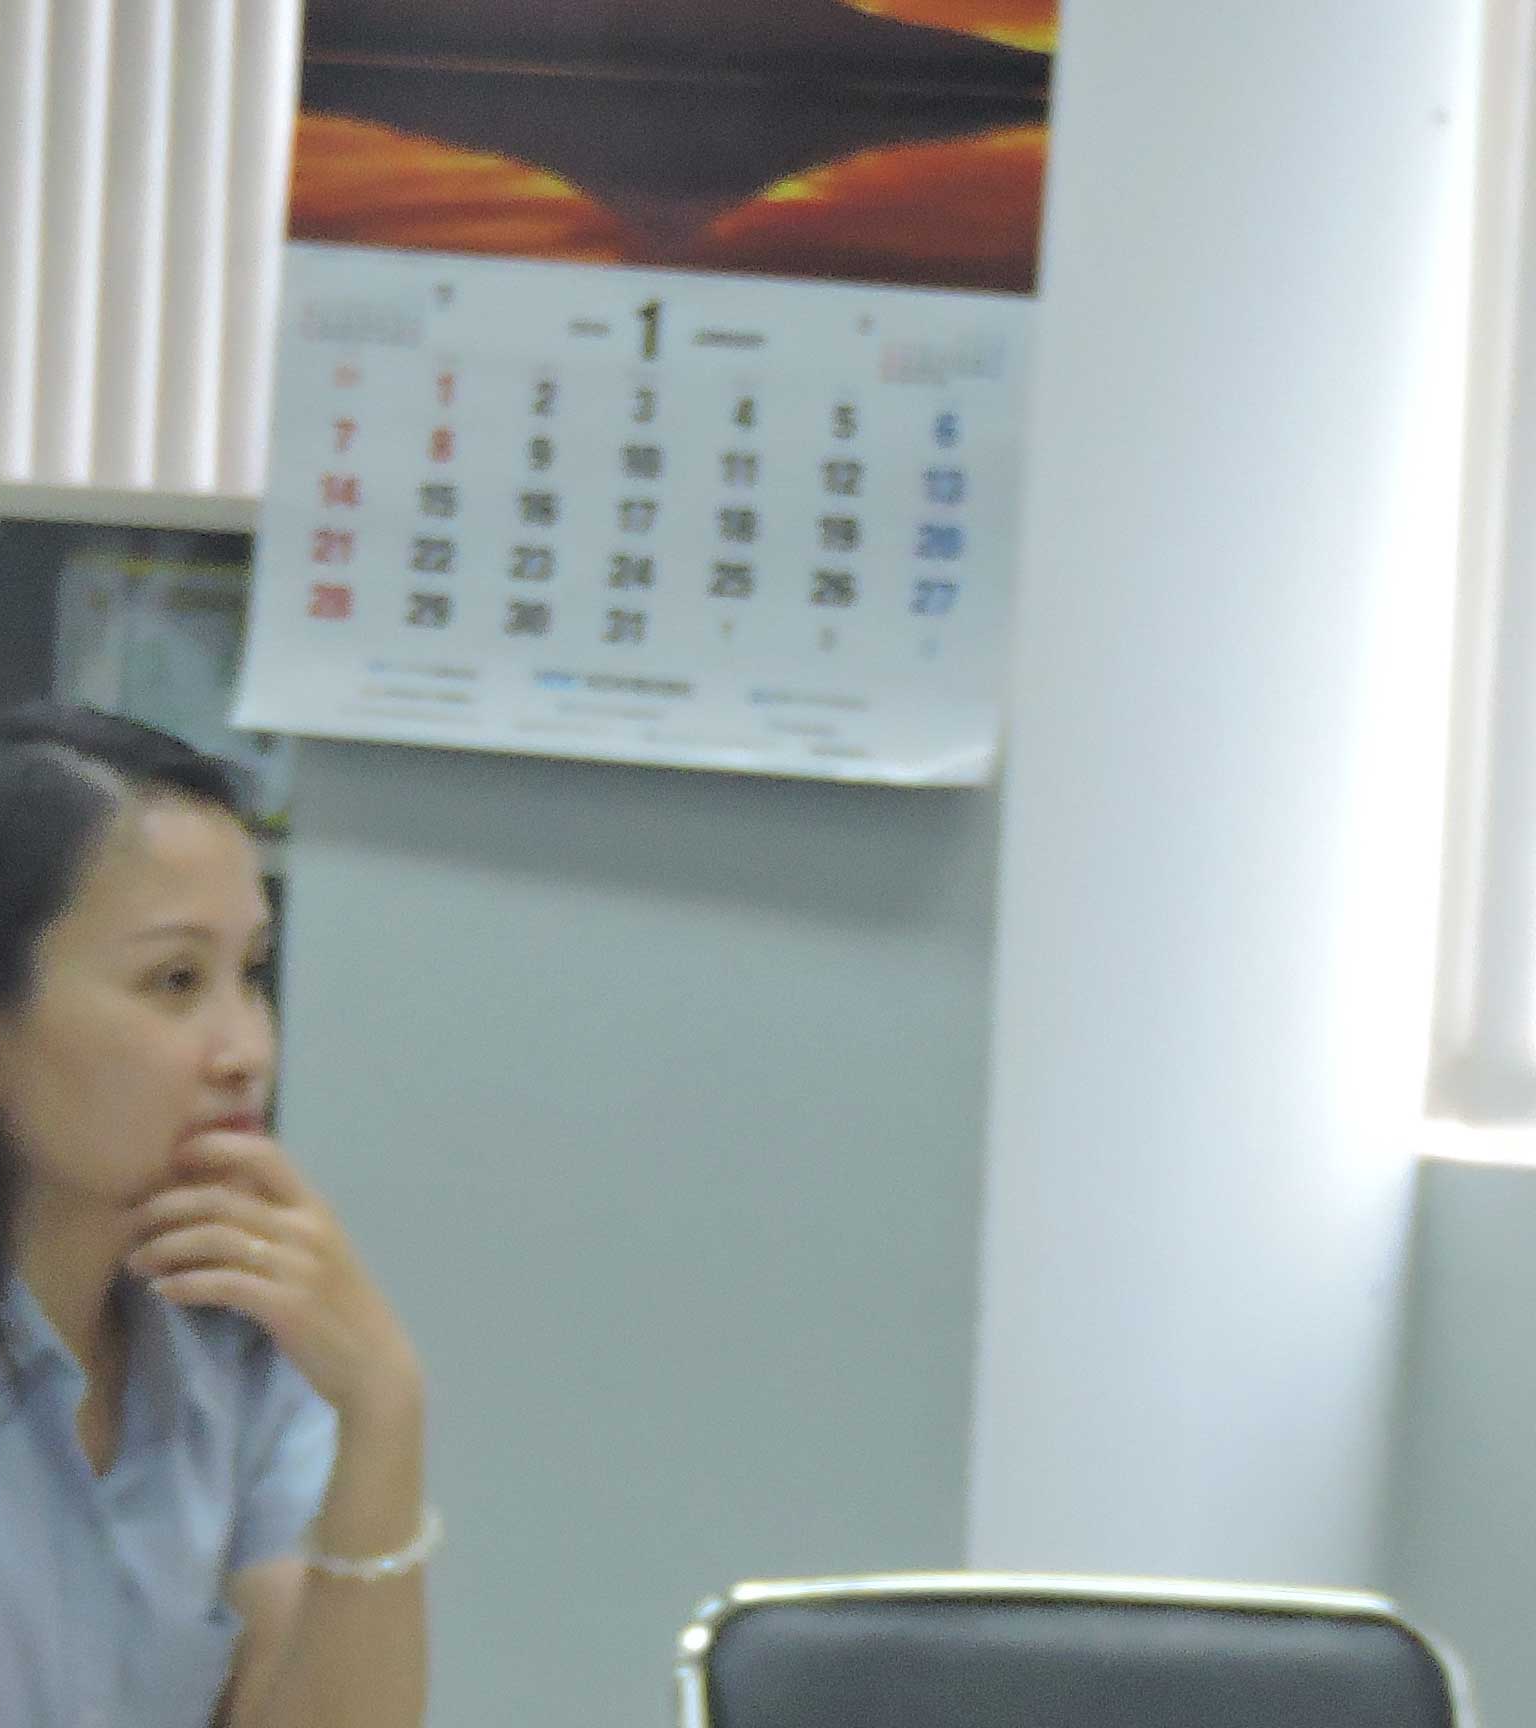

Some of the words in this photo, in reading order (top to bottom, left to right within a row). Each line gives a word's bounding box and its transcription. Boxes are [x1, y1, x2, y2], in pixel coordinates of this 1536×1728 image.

[638, 298, 662, 362] 1
[436, 372, 454, 404] 1
[534, 379, 556, 416] 2
[634, 388, 654, 423] 3
[733, 397, 757, 430] 4
[835, 404, 857, 440] 5
[935, 412, 960, 449] 6
[334, 418, 357, 450] 7
[430, 427, 452, 461] 8
[529, 437, 553, 472] 9
[623, 443, 662, 479] 10
[723, 451, 759, 484] 11
[824, 459, 863, 496] 12
[925, 468, 965, 505] 13
[323, 474, 359, 506] 14
[419, 483, 457, 518] 15
[519, 490, 559, 526] 16
[618, 498, 658, 533] 17
[718, 506, 758, 543] 18
[820, 515, 861, 552] 19
[917, 521, 964, 560] 20
[312, 529, 354, 564] 21
[411, 536, 456, 574] 22
[509, 545, 554, 582] 23
[609, 553, 654, 590] 24
[710, 561, 755, 598] 25
[811, 569, 856, 606] 26
[912, 578, 959, 615] 27
[309, 583, 352, 619] 28
[406, 592, 453, 630] 29
[508, 600, 550, 637] 30
[606, 608, 647, 644] 31
